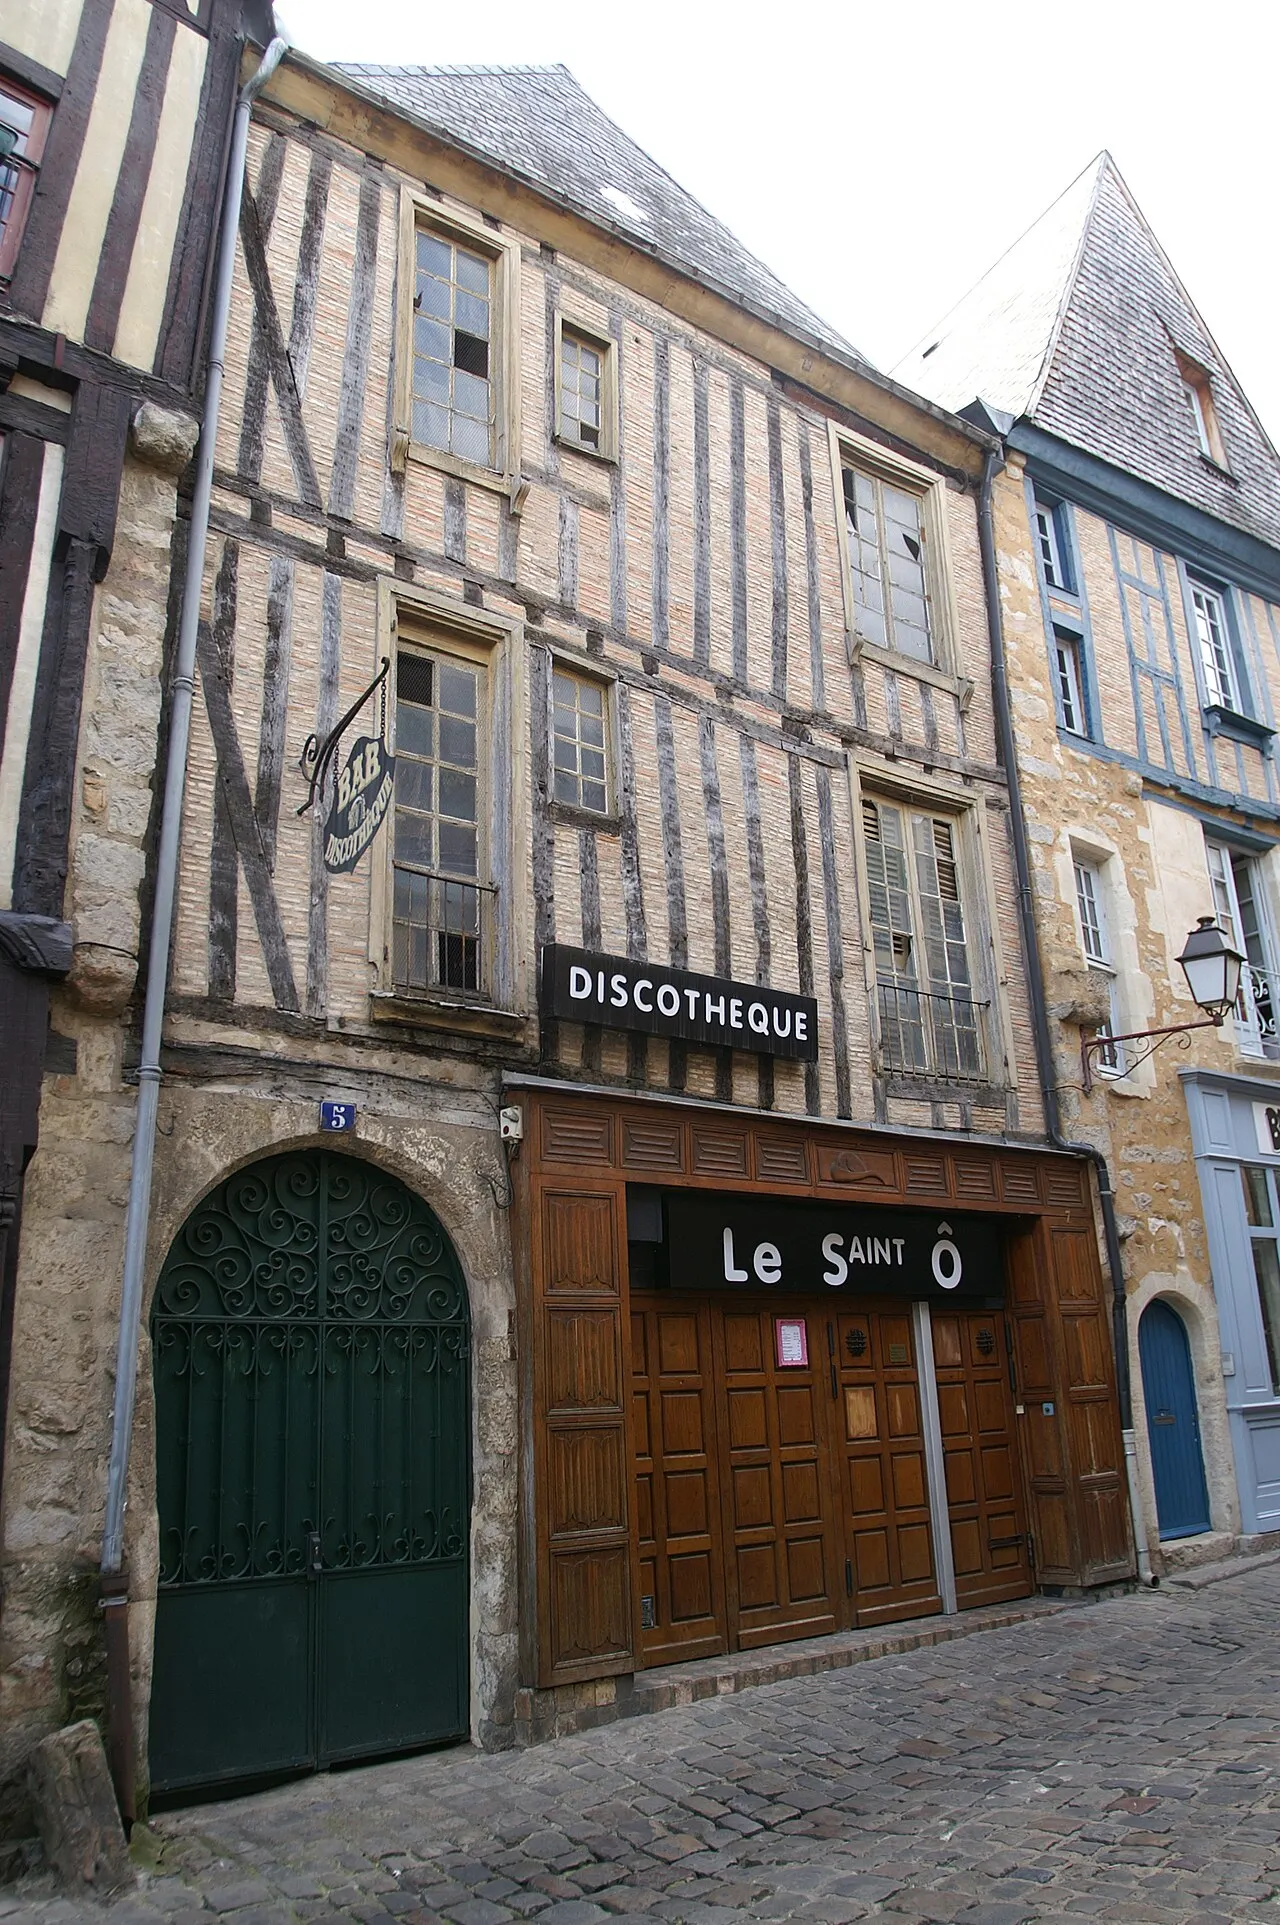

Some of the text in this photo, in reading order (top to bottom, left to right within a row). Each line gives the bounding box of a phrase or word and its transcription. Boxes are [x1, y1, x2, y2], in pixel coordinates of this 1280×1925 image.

[337, 741, 381, 814] BAR
[569, 965, 808, 1041] DISCOTHEQUE
[331, 1105, 346, 1128] 5
[723, 1220, 962, 1289] Le SAINT Ô
